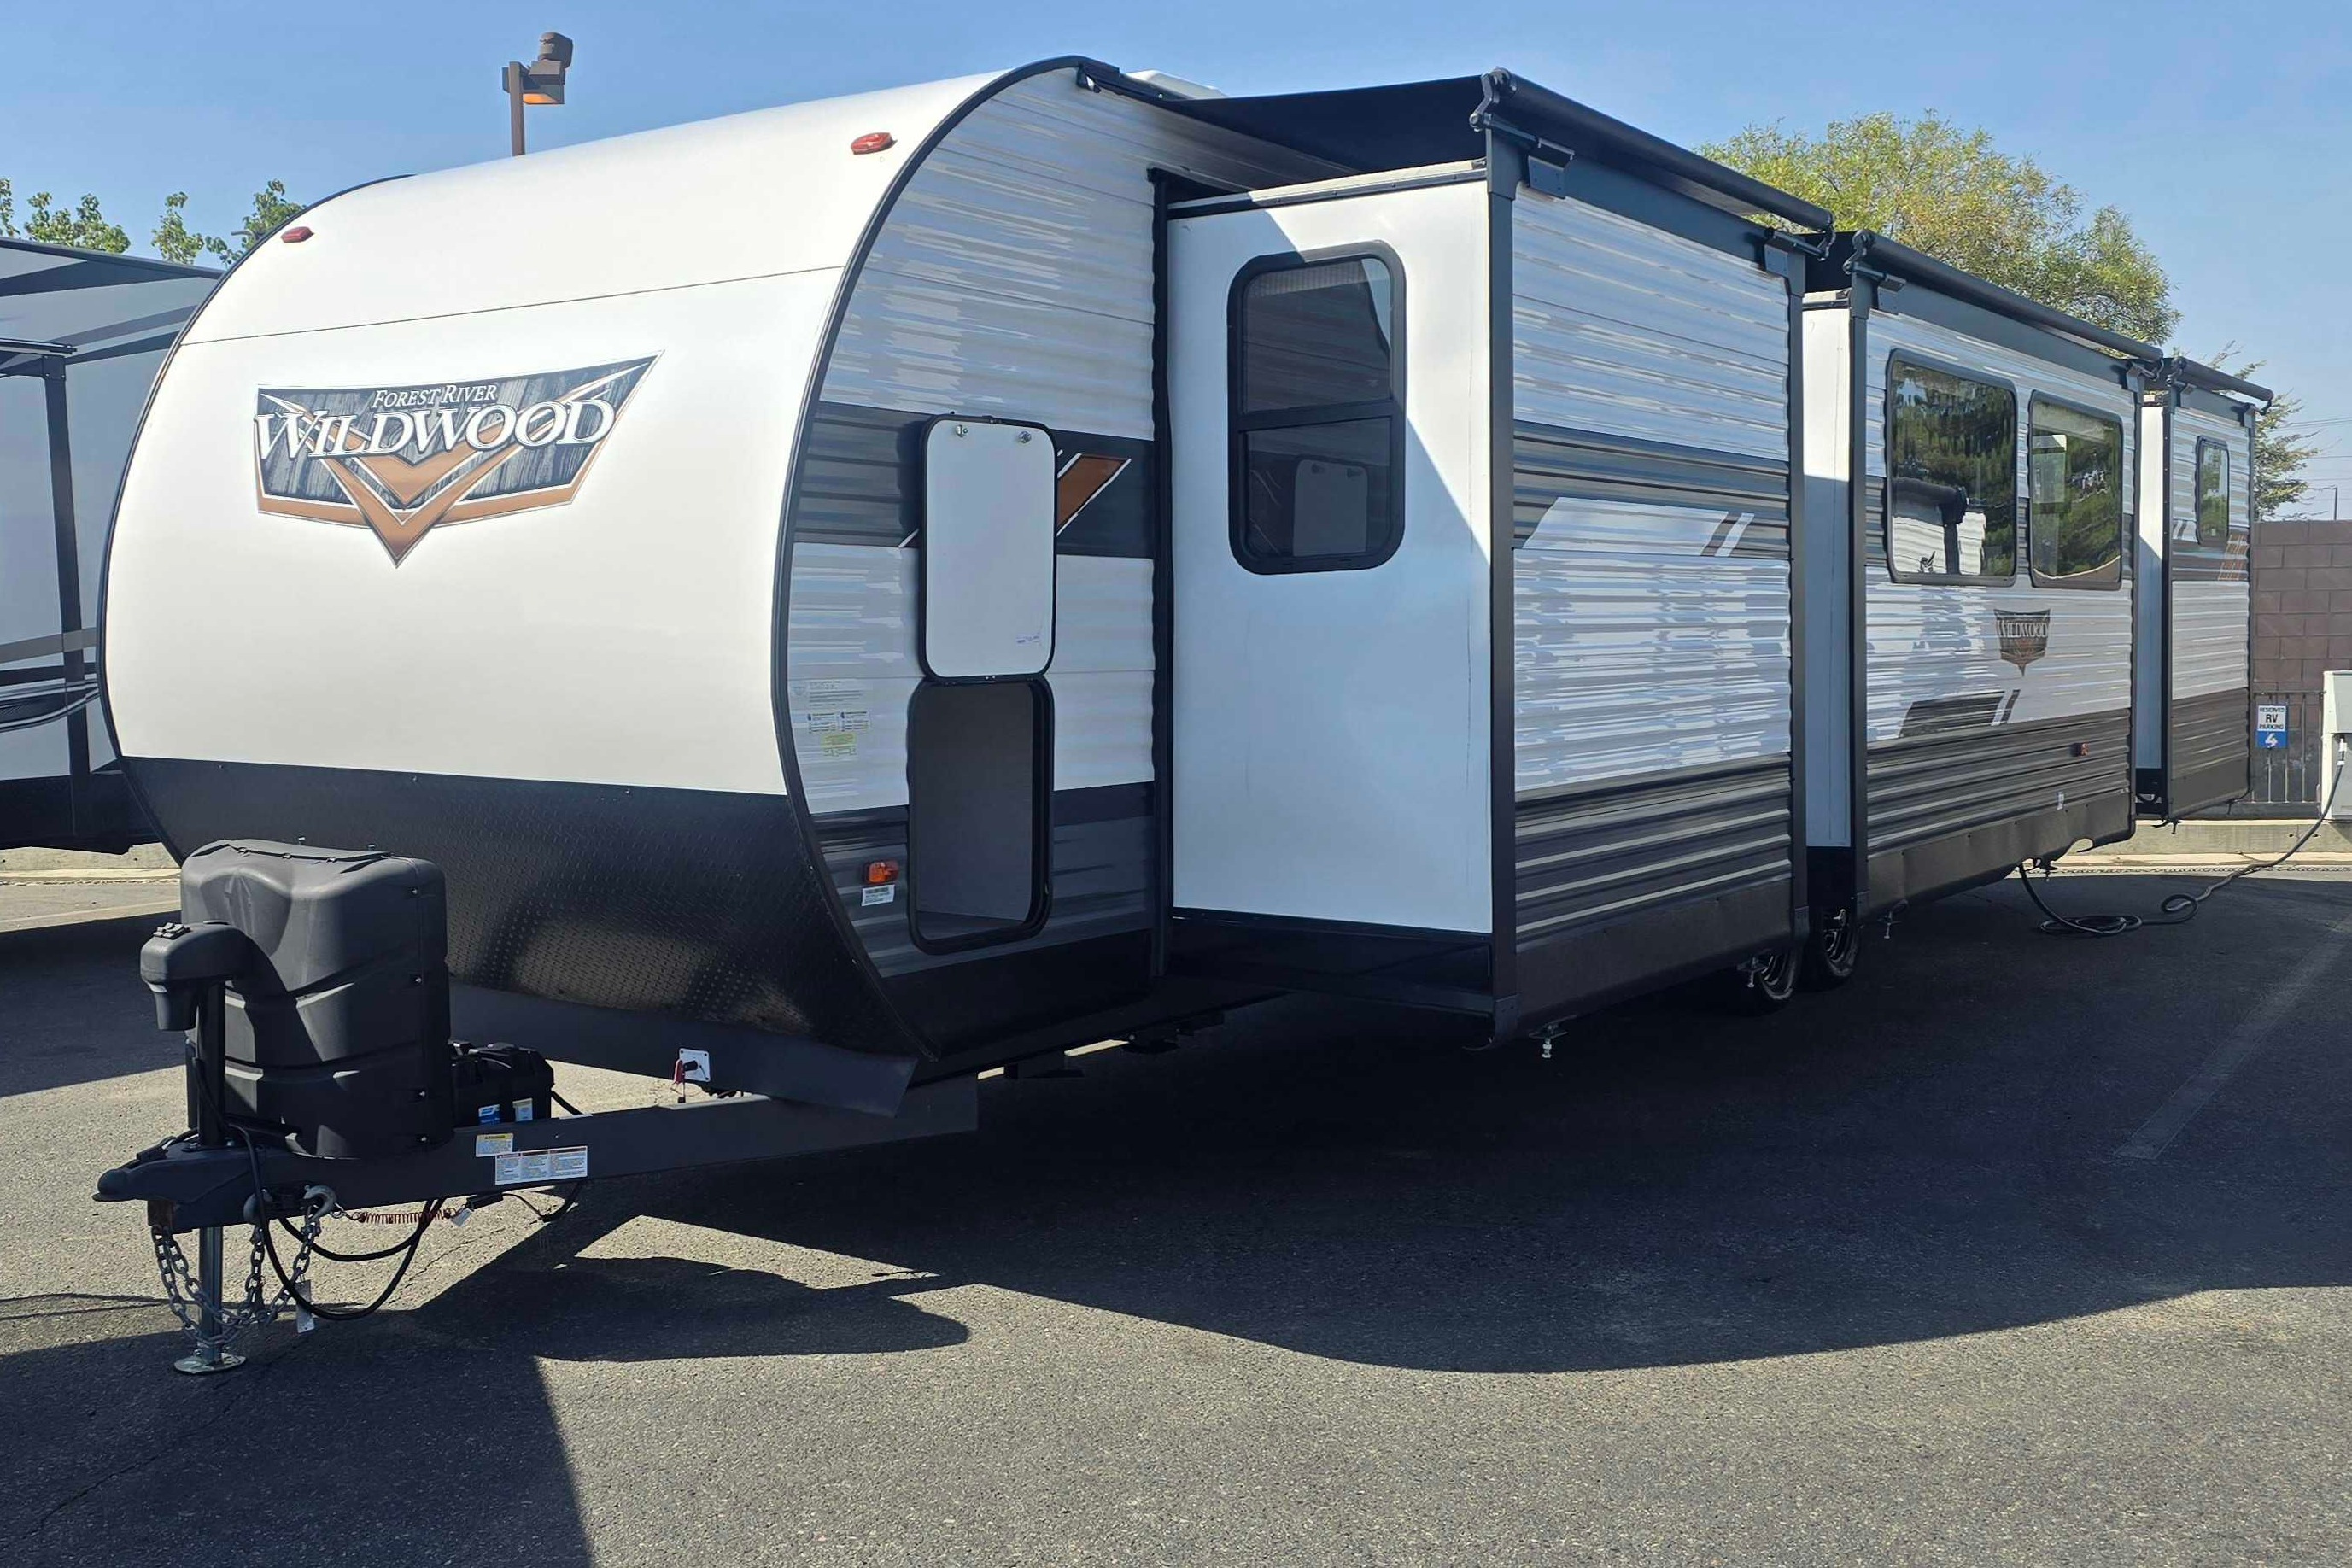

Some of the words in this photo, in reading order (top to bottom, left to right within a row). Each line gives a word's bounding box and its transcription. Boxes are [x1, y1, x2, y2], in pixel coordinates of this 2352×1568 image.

[372, 389, 442, 407] FOREST
[443, 384, 497, 401] RIVER
[255, 399, 615, 459] WILDWOOD
[2266, 713, 2279, 723] RV
